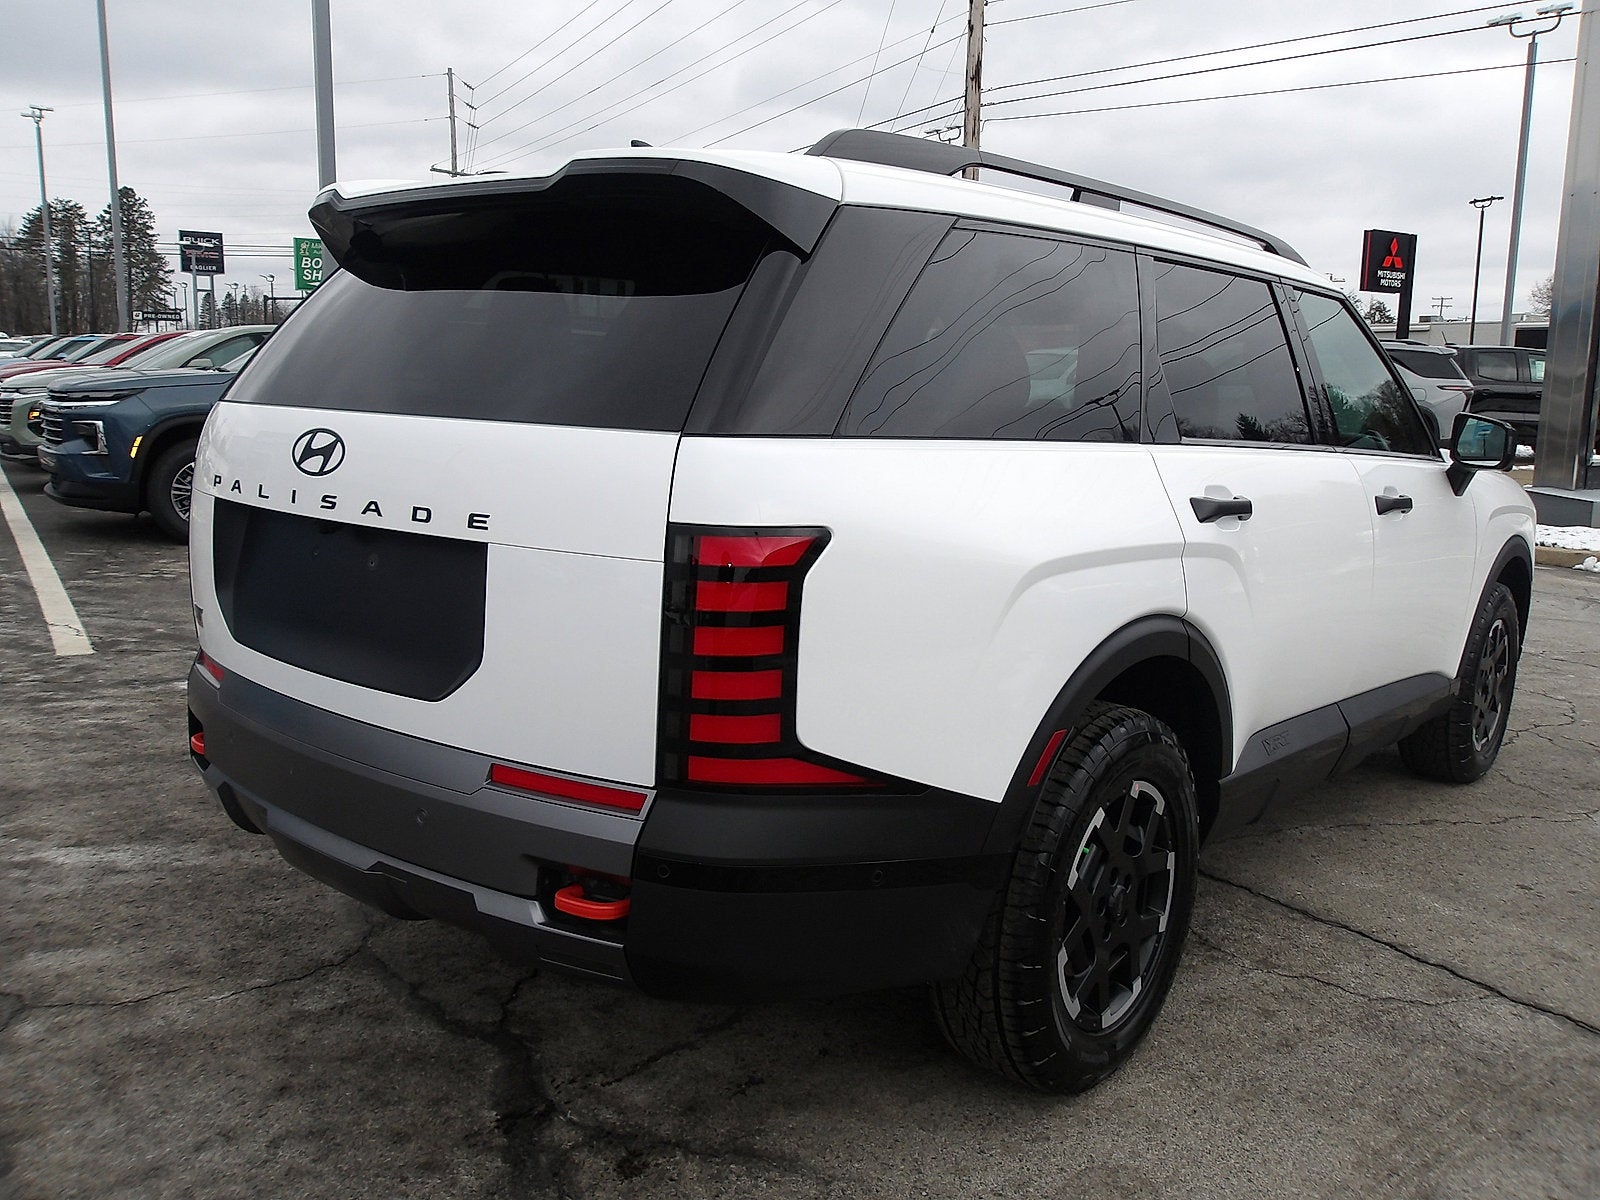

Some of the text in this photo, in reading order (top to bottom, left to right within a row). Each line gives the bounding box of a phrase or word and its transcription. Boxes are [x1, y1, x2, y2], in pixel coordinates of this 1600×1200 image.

[183, 236, 220, 245] BUICK
[1377, 270, 1406, 280] MITSUBISHI
[1380, 279, 1402, 288] MOTORS
[143, 312, 180, 320] PRE-OWNED
[213, 474, 491, 532] PALISADE
